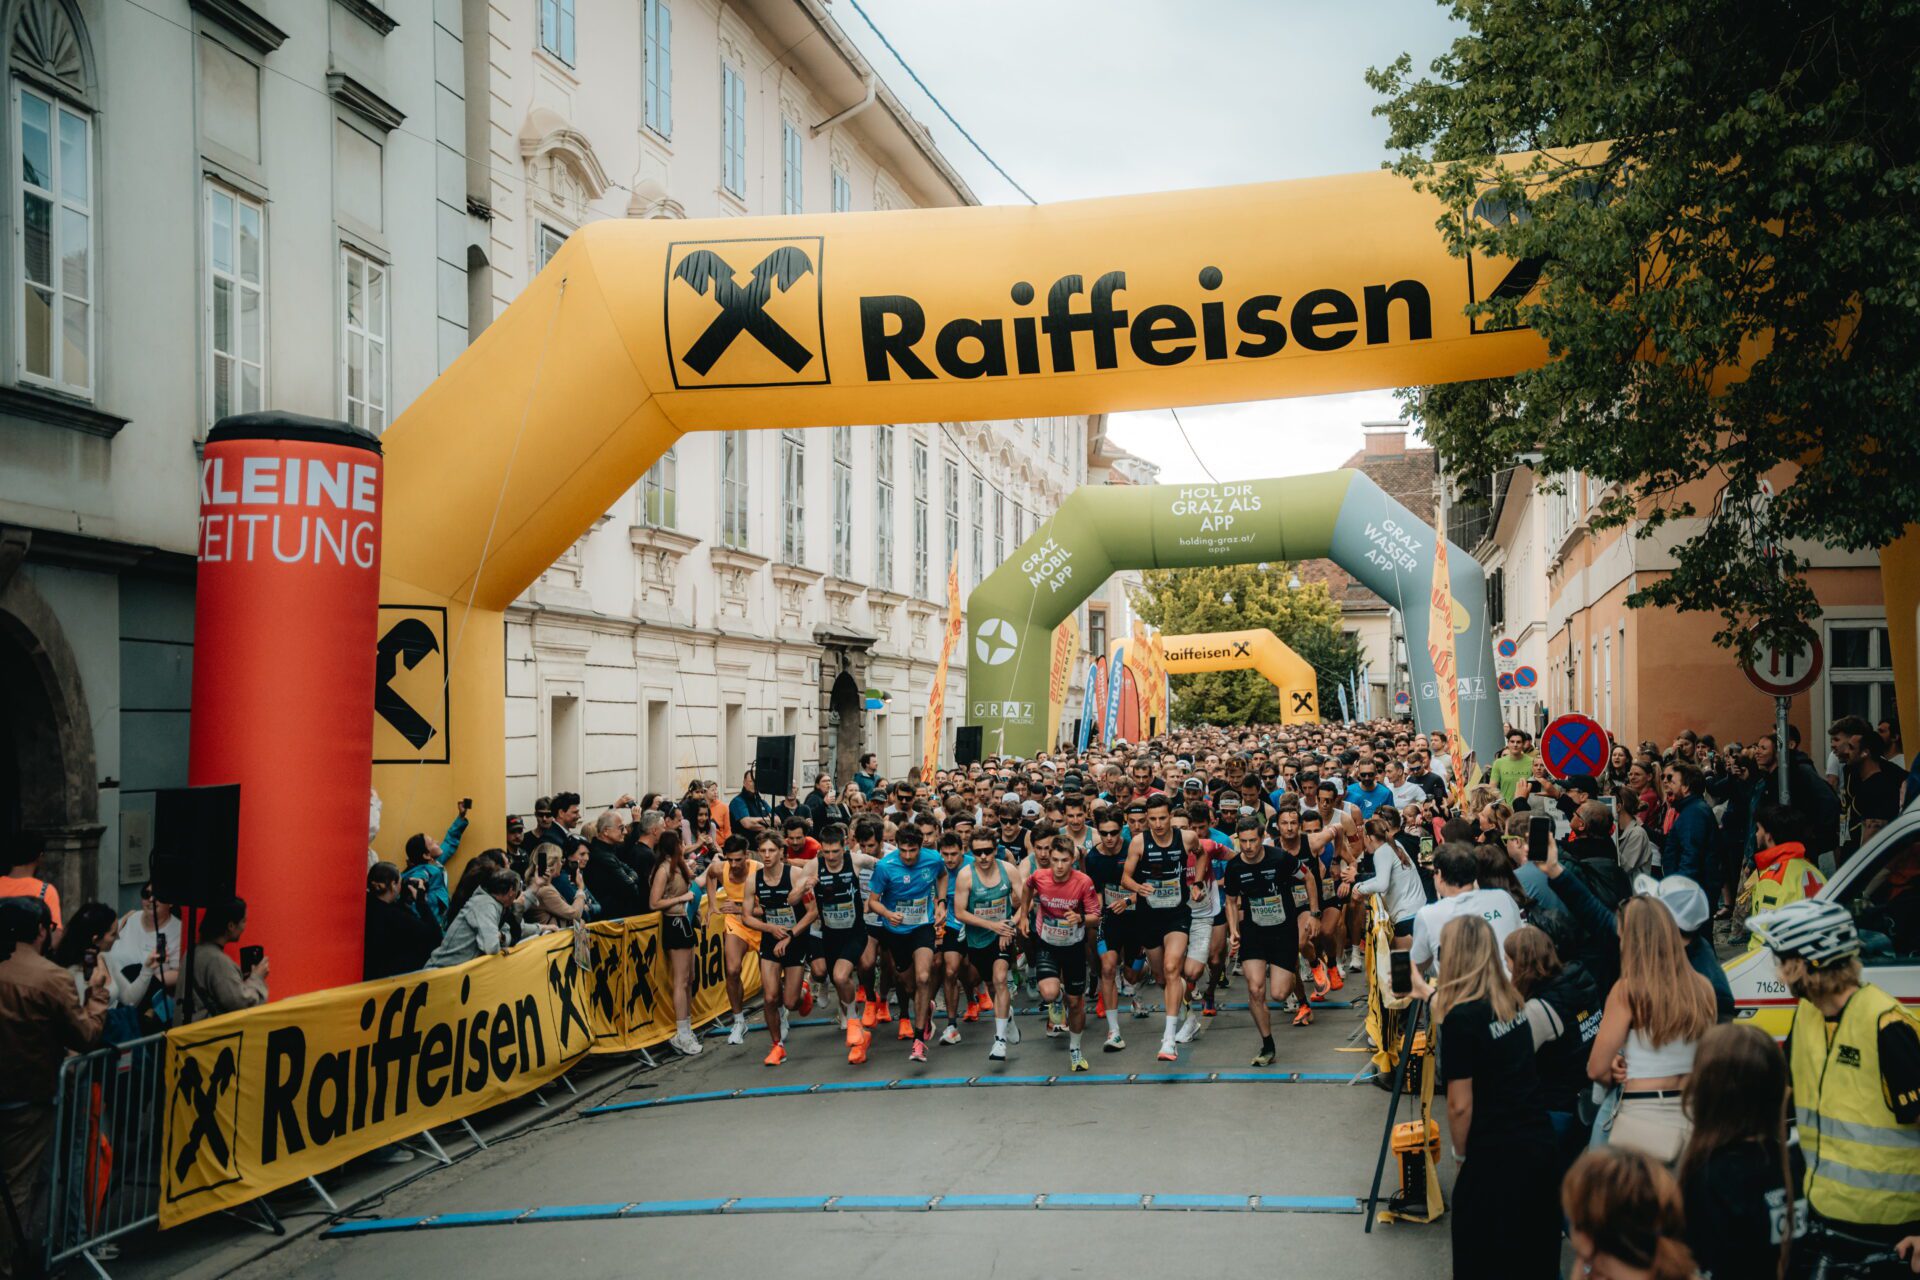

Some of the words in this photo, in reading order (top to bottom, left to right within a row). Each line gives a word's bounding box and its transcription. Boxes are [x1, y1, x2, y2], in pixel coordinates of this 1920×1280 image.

[859, 266, 1433, 382] Raiffeisen
[1180, 487, 1219, 499] HOL
[1223, 485, 1253, 497] DIR
[1171, 499, 1224, 515] GRAZ
[1229, 496, 1262, 512] ALS
[1200, 515, 1234, 532] APP
[1364, 522, 1418, 573] WASSER
[1382, 519, 1422, 554] GRAZ
[1021, 537, 1058, 573] GRAZ
[1208, 546, 1230, 554] apps
[1364, 549, 1393, 571] APP
[1029, 548, 1072, 588] MOBIL
[1049, 565, 1072, 593] APP
[1423, 679, 1483, 697] GAZ
[974, 703, 1032, 717] GRAZ
[261, 974, 547, 1165] Raiffeisen
